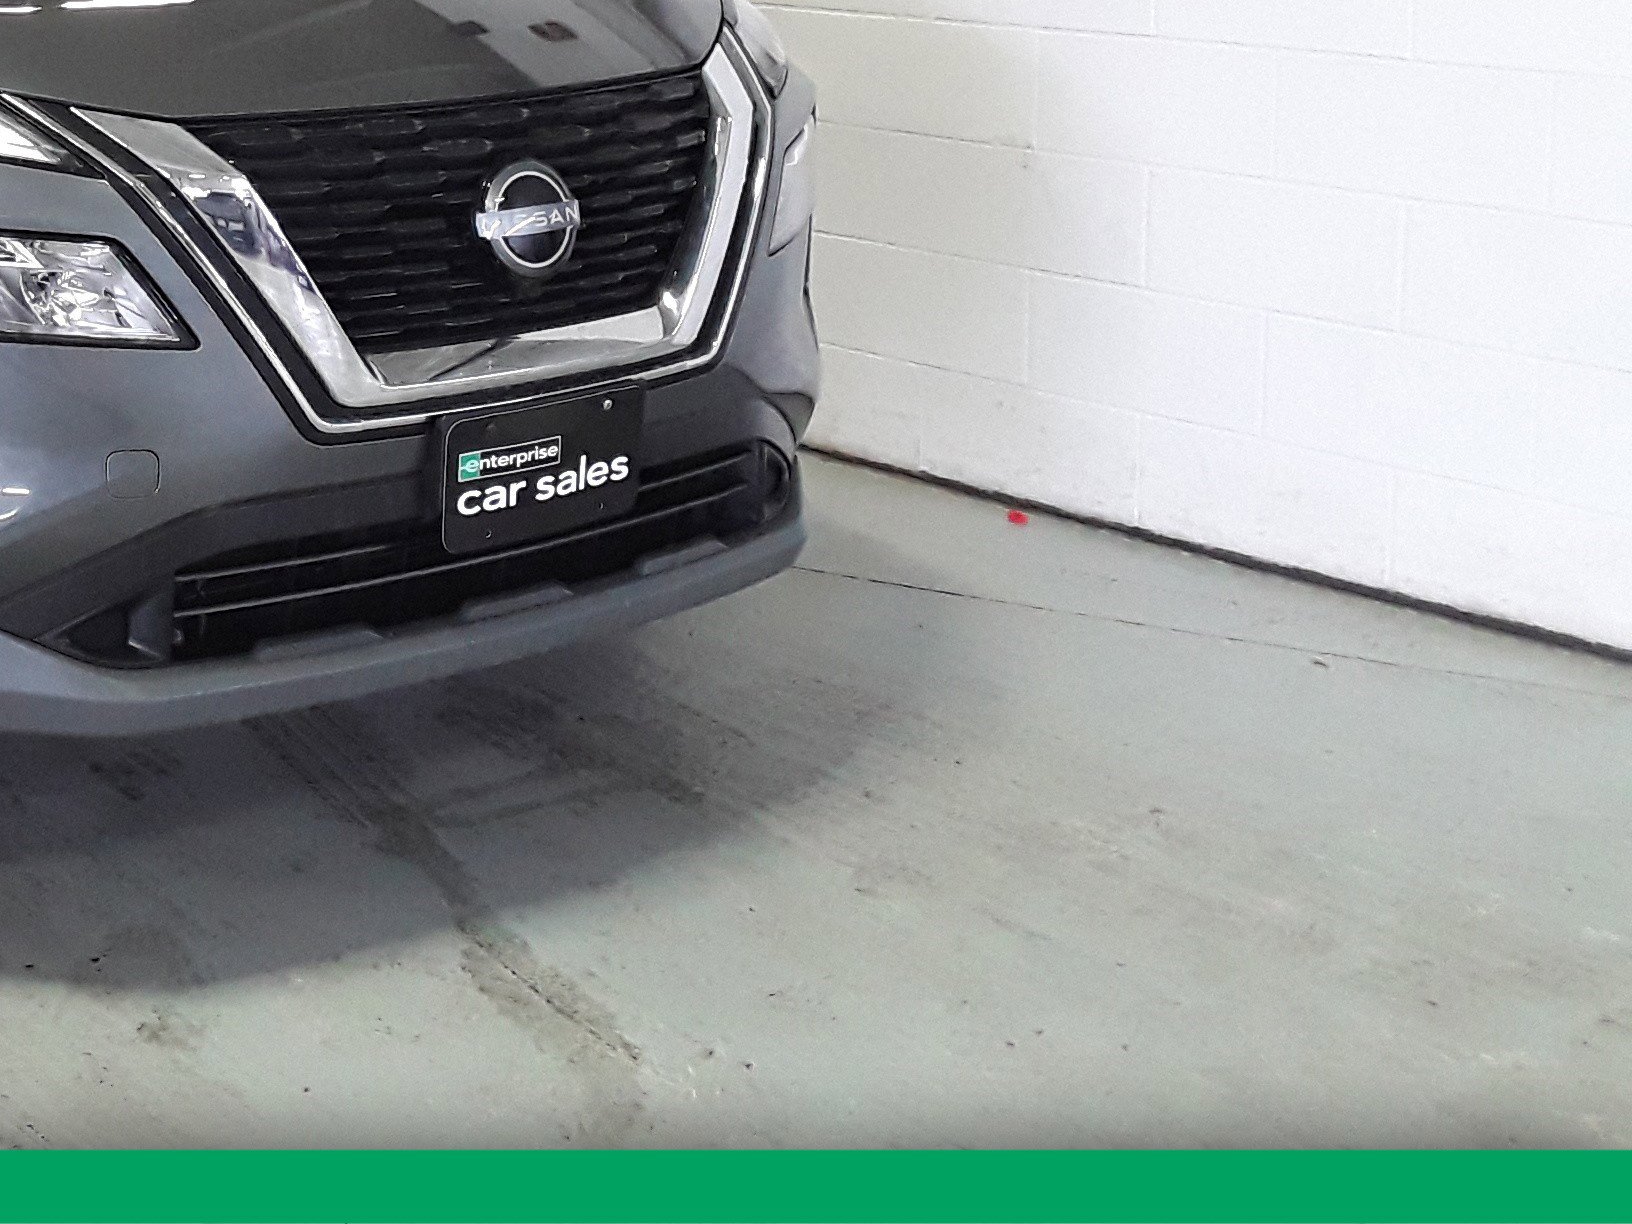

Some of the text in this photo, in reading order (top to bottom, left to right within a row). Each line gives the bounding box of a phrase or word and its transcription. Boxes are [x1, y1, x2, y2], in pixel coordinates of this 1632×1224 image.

[480, 201, 579, 239] NSSAN
[462, 445, 559, 473] enterprise
[457, 455, 629, 515] car sales
